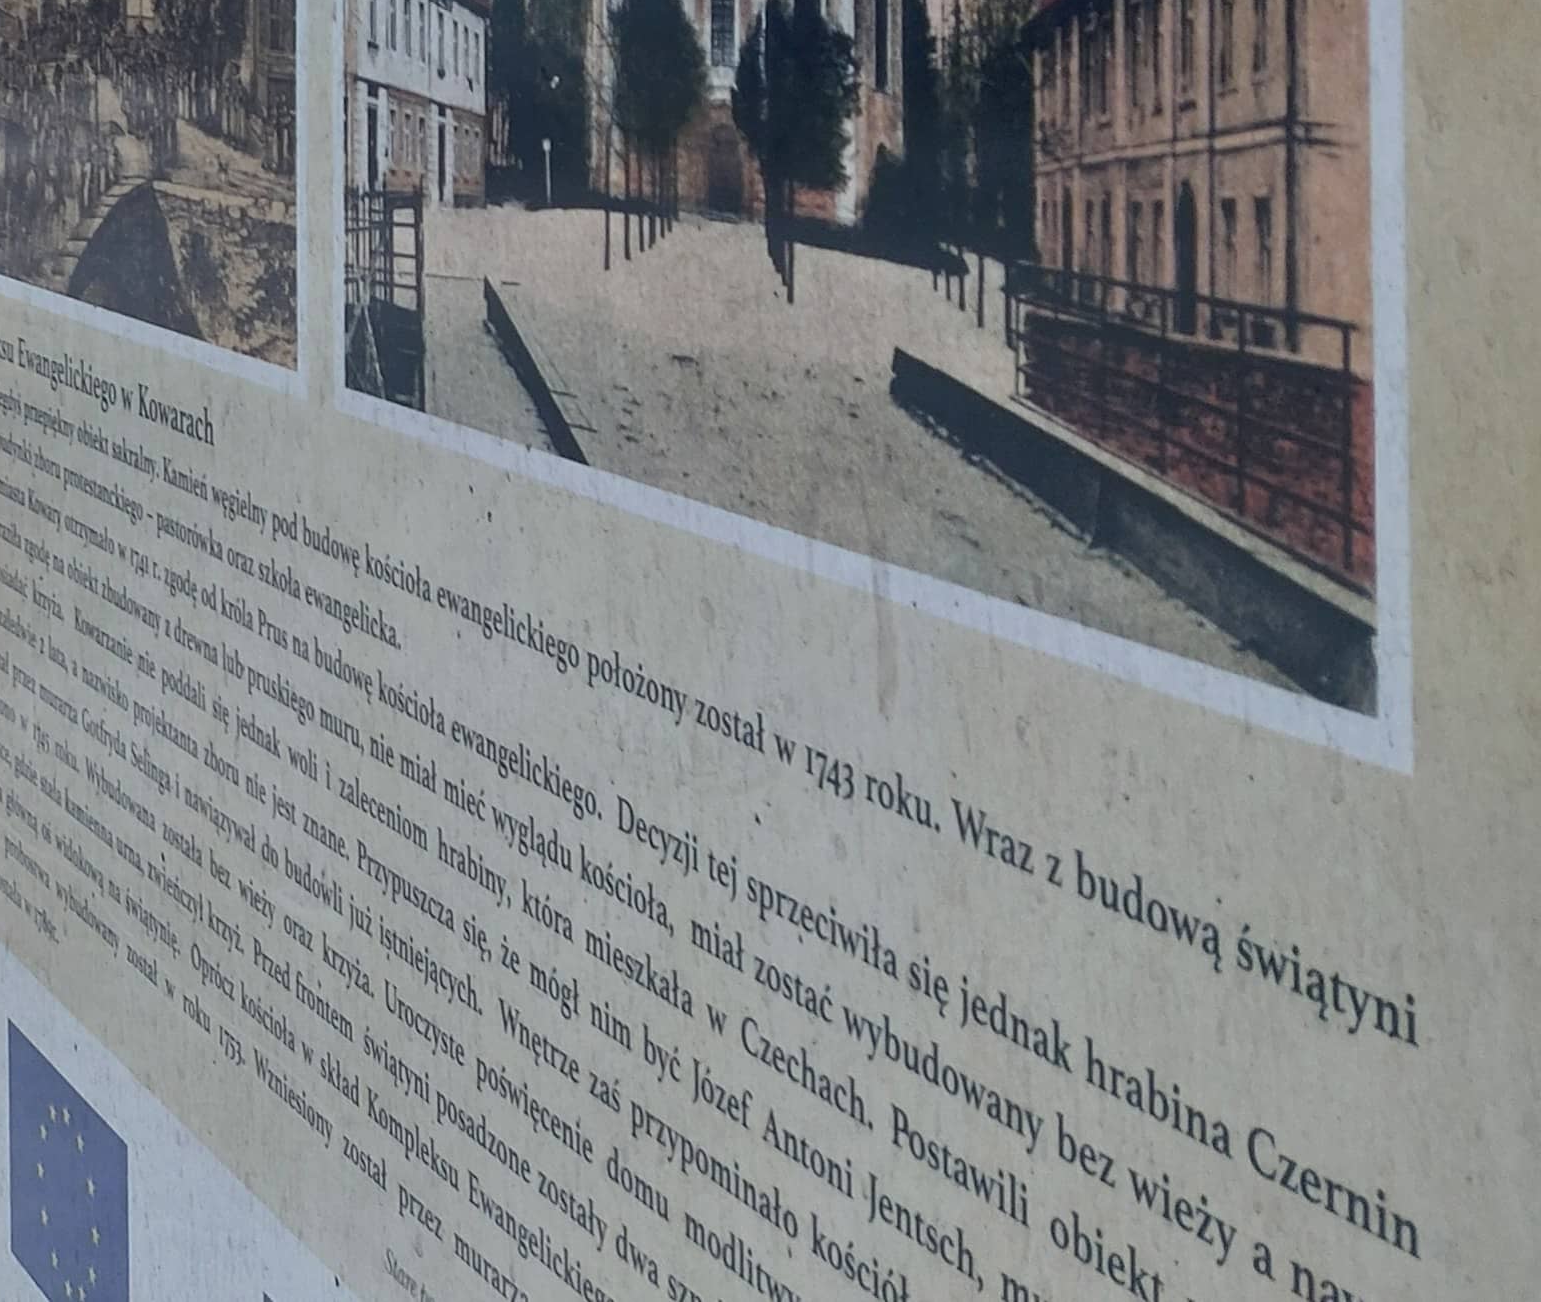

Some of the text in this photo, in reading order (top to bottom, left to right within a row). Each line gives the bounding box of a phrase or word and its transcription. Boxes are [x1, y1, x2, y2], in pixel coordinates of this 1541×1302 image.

[120, 386, 134, 411] w
[137, 382, 215, 447] Kowarach
[156, 511, 402, 651] pastorówka oraz szkoła ewangelicka.
[272, 511, 1419, 1048] pod budowę kościoła ewangelickiego położony został w 1743 roku. Wraz z budową świątyni
[302, 812, 984, 1293] znane. Przypuszcza się, że mógł nim być Józef Antoni Jentsch,
[313, 635, 1420, 1259] budowę kościoła ewangelickiego. Decyzji tej sprzeciwiła się jednak hrabina Czernin
[319, 707, 1276, 1282] muru, nie miał mieć wyglądu kościoła, miał zostać wybudowany bez wieży a
[322, 931, 670, 1222] krzyża. Uroczyste poświęcenie domu
[338, 776, 429, 852] zaleceniom
[437, 826, 512, 909] hrabiny,
[521, 878, 574, 944] która
[584, 929, 694, 1018] mieszkała
[706, 1003, 728, 1036] w
[741, 1016, 874, 1131] Czechach.
[891, 1103, 1030, 1228] Postawili
[349, 894, 373, 938] już
[379, 915, 483, 1016] istniejących.
[498, 997, 580, 1084] Wnętrze
[588, 1071, 621, 1114] zaś
[630, 1100, 799, 1239] przypominało
[219, 1025, 443, 1242] 1753. Wzniesiony został przez
[295, 970, 660, 1289] frontem świątyni posadzone zostały dwa
[320, 1051, 460, 1192] skład Kompleksu
